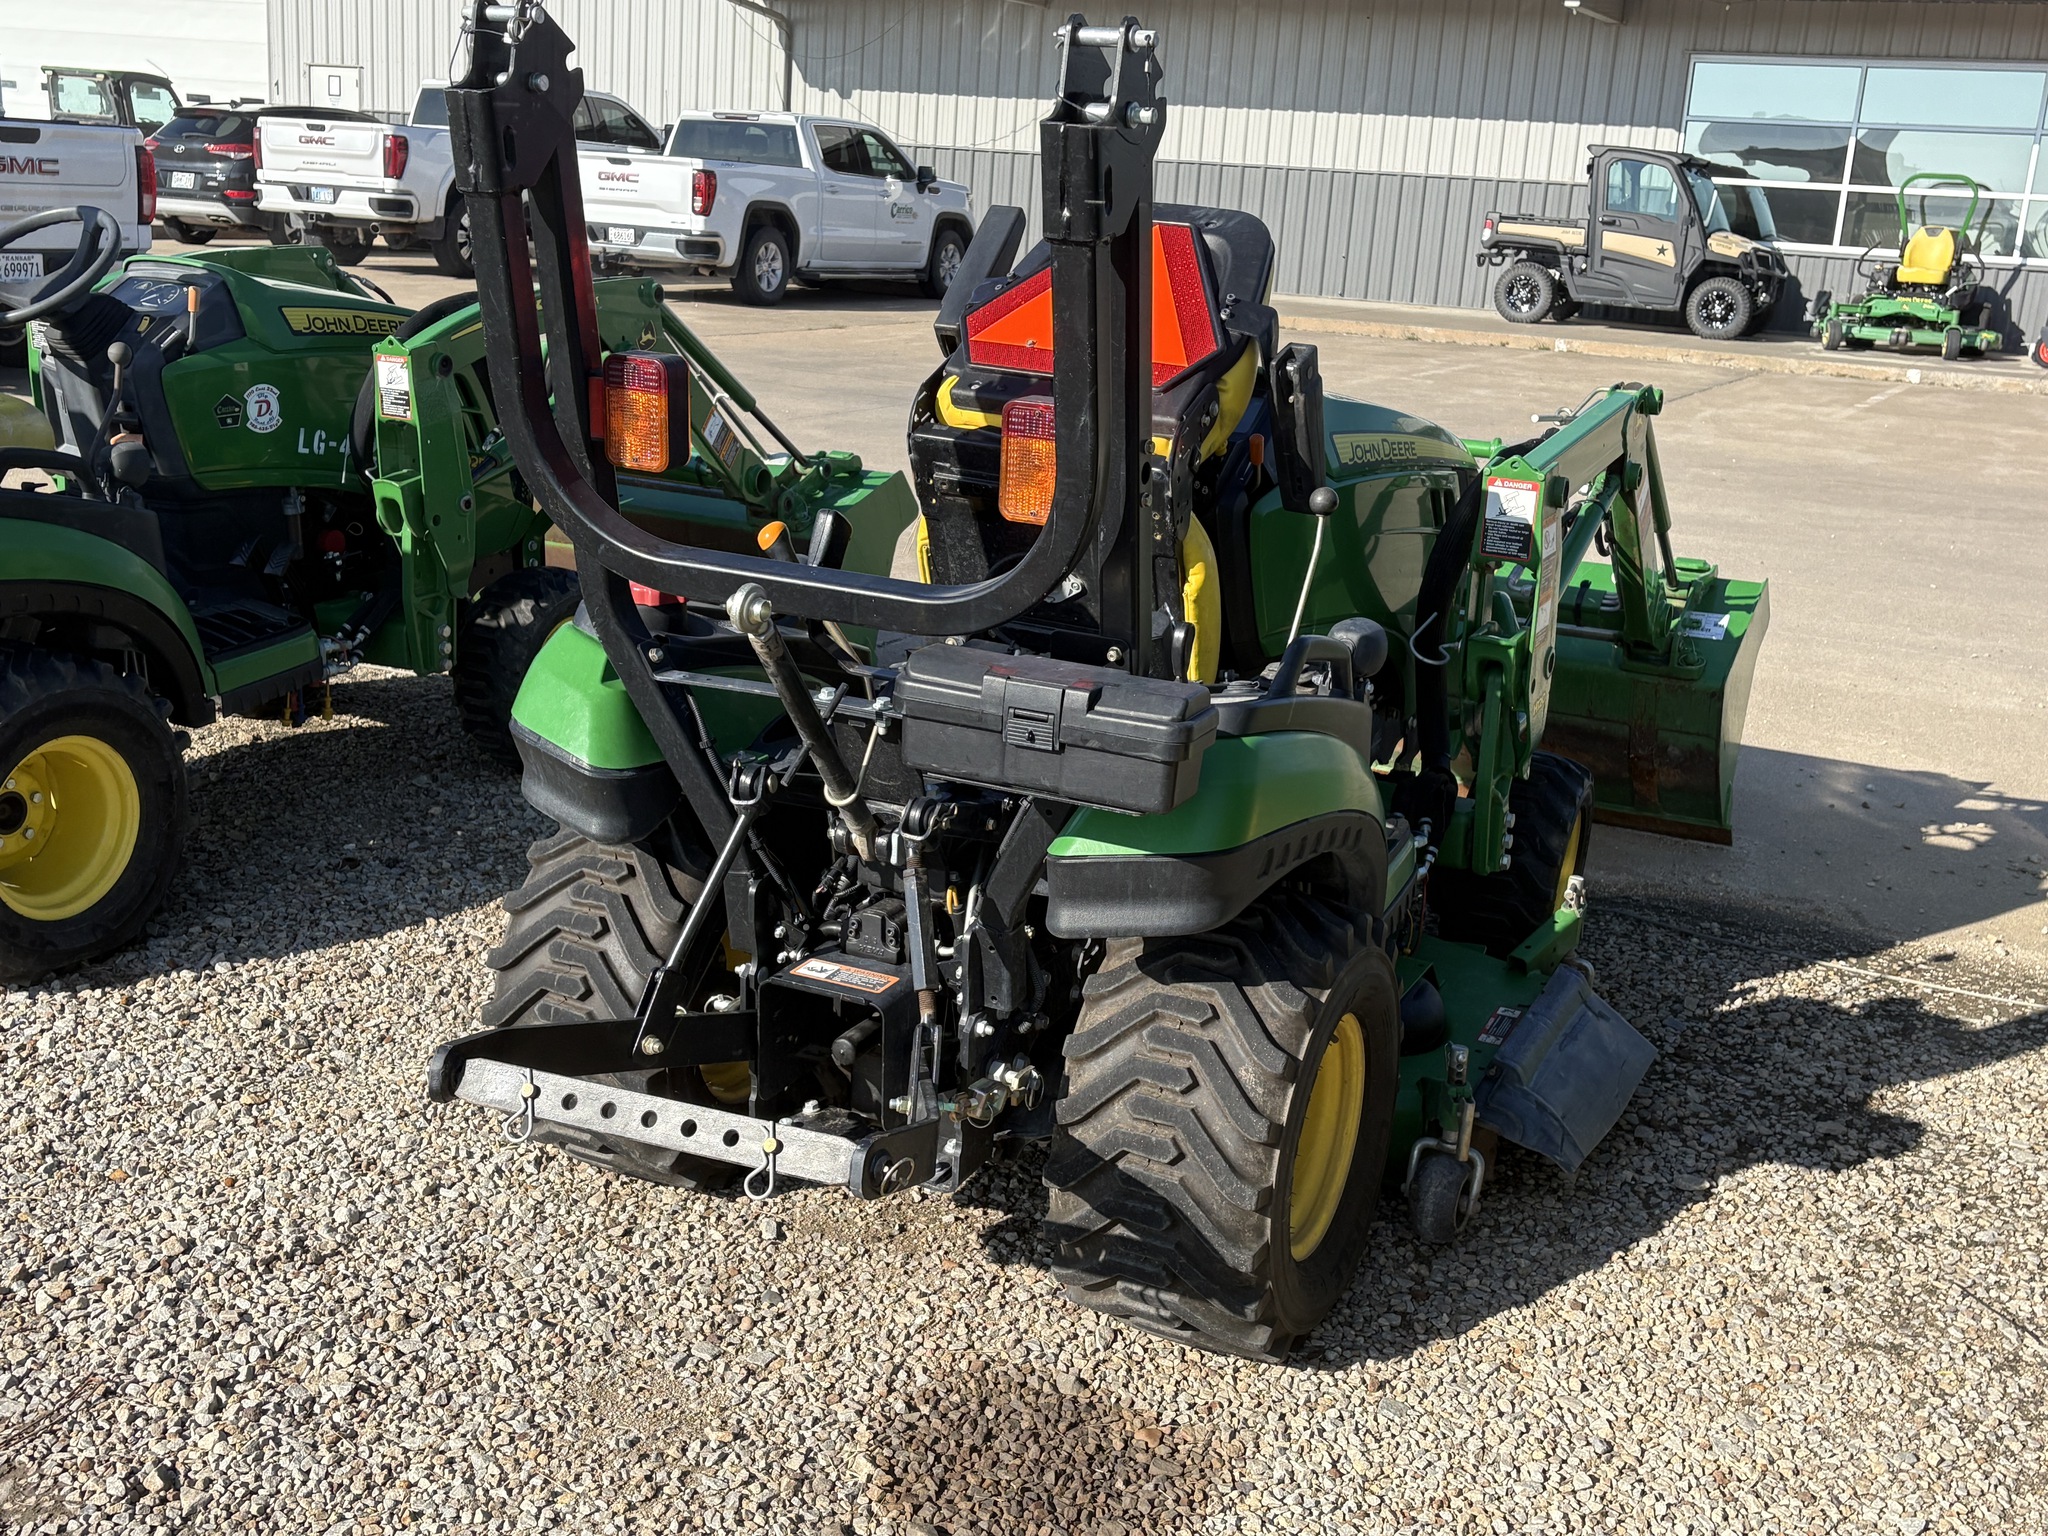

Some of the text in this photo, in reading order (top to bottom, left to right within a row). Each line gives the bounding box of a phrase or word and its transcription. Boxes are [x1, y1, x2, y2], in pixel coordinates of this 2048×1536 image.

[299, 135, 335, 146] GMC
[598, 171, 639, 183] GMC
[3, 262, 41, 278] 699971
[302, 313, 351, 331] JOHN
[1349, 438, 1417, 462] JOHN DEERE
[1503, 480, 1533, 490] DANGER
